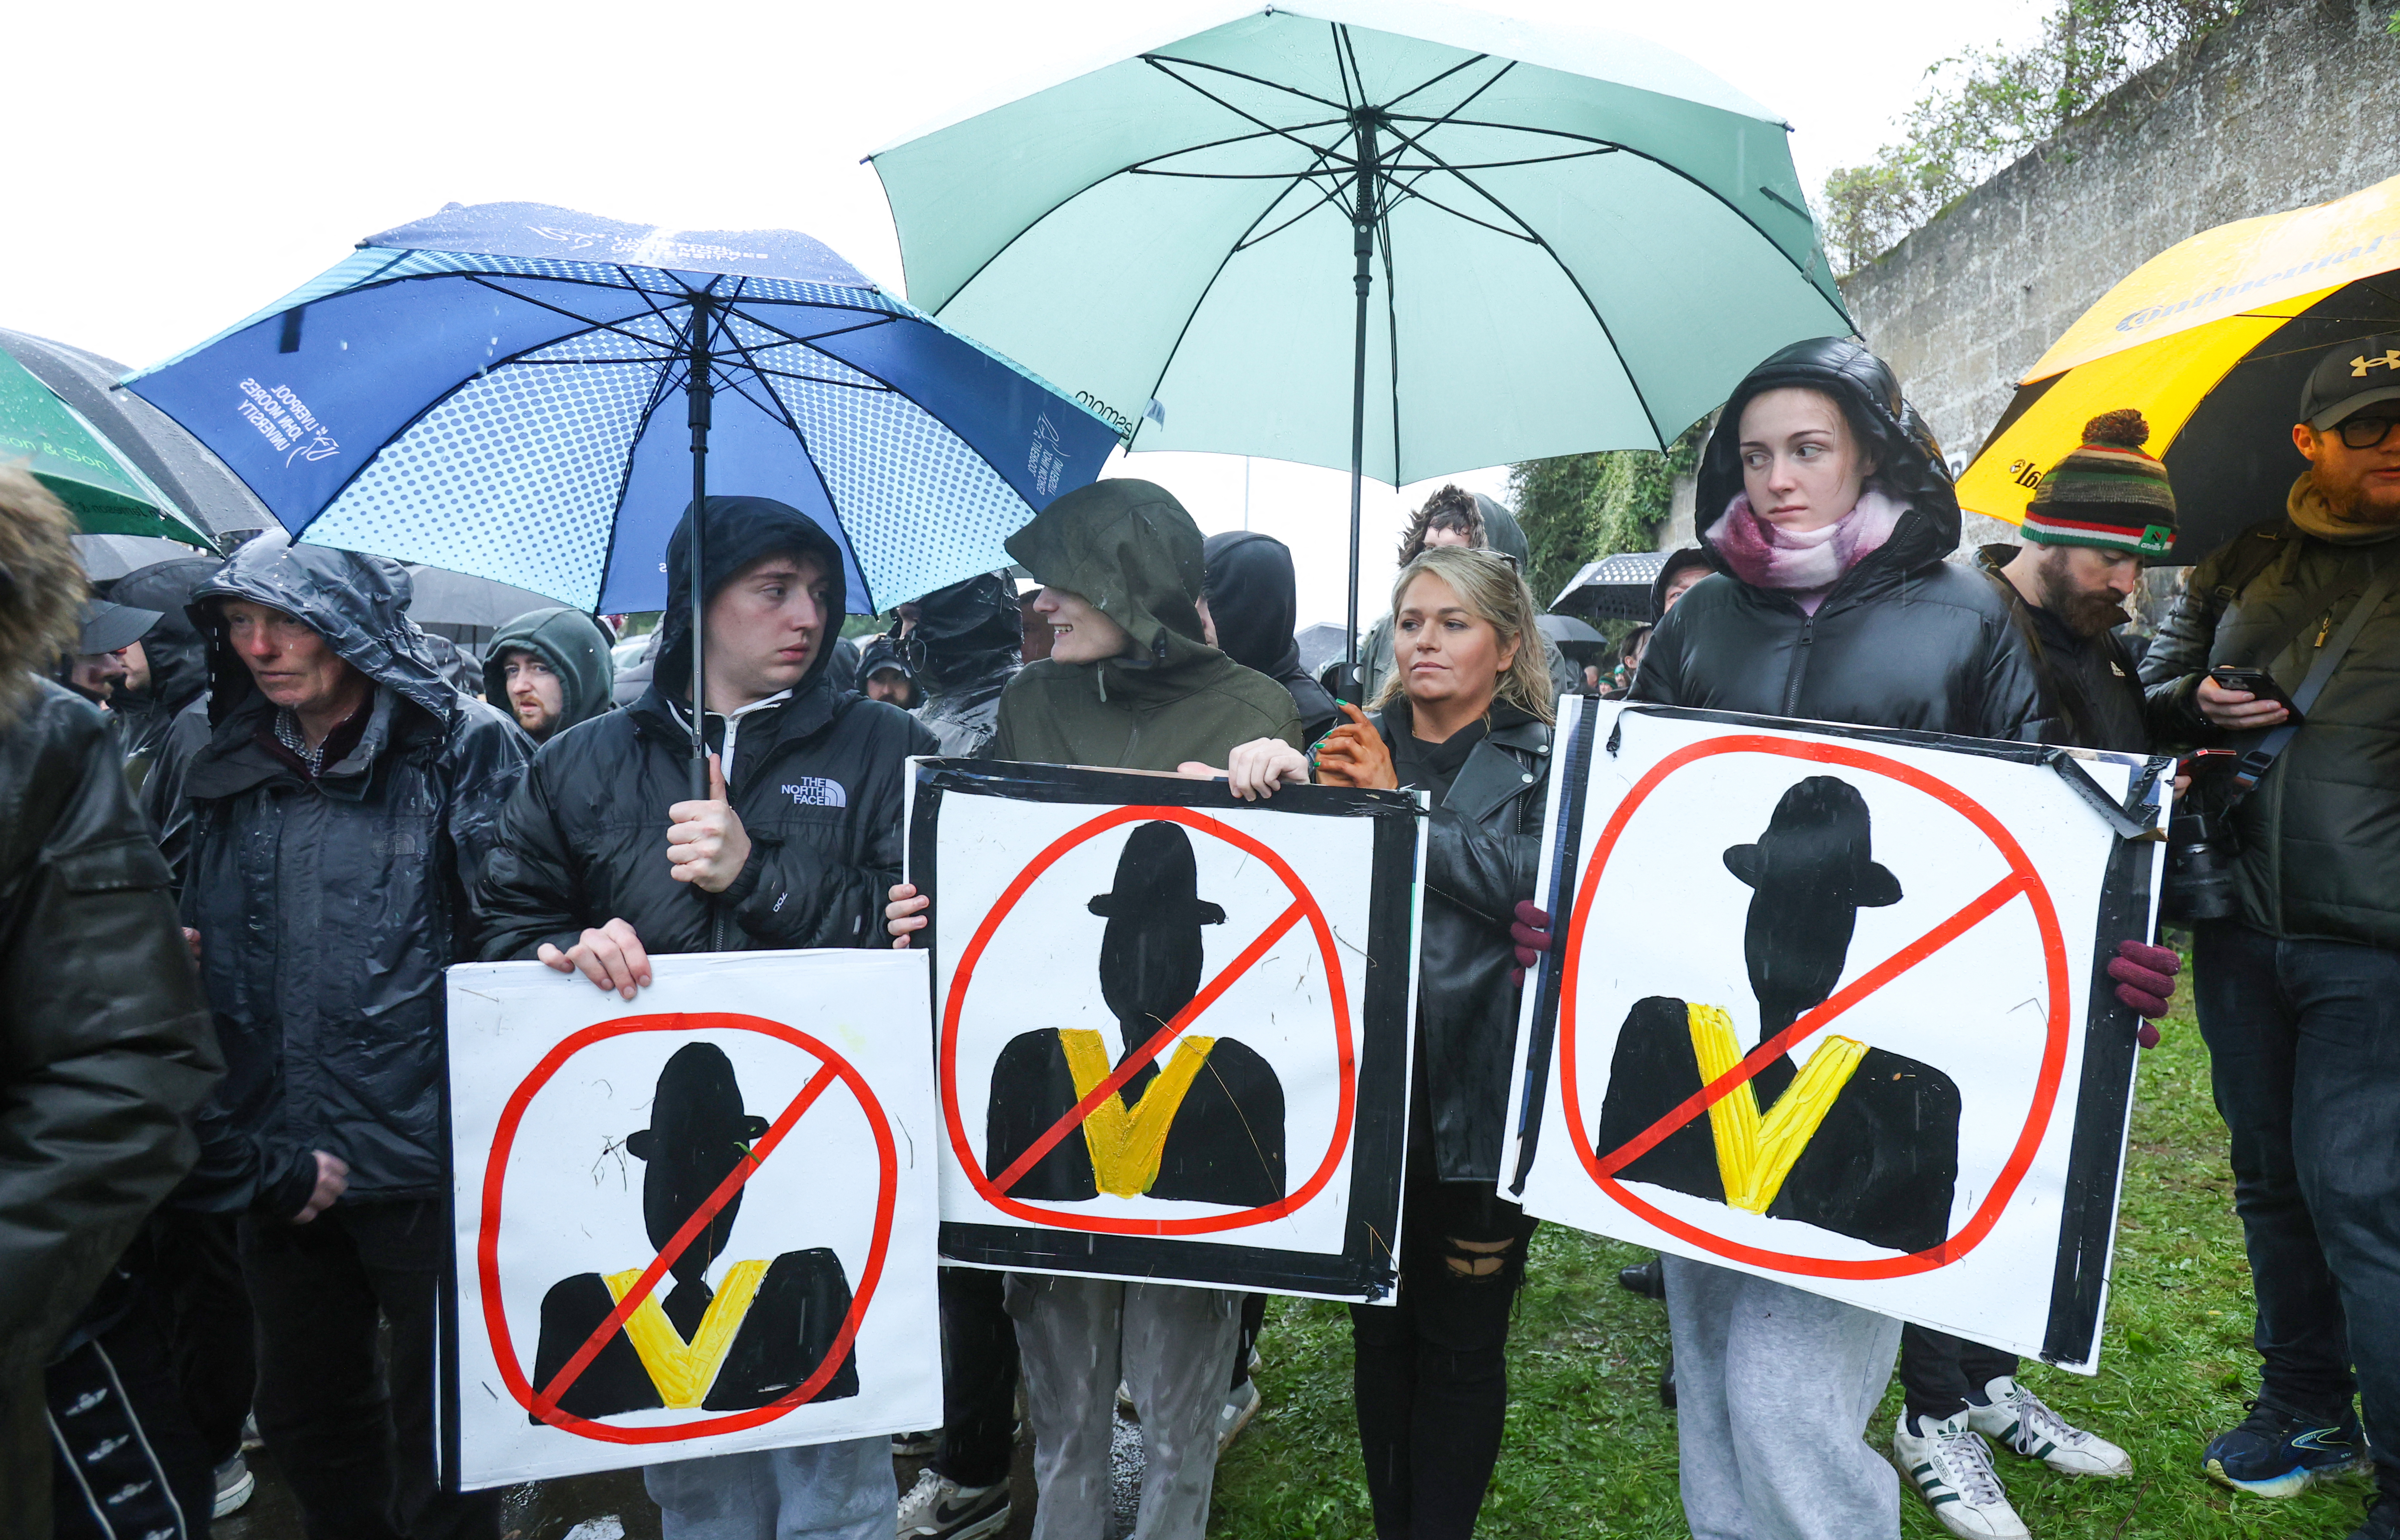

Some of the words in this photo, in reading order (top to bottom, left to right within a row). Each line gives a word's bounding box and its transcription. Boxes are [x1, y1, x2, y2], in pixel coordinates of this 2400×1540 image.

[679, 247, 768, 259] MOORES
[43, 442, 60, 457] &
[63, 447, 109, 470] Son
[801, 776, 825, 787] THE
[781, 784, 825, 796] NORTH
[793, 794, 825, 806] FACE
[2299, 1433, 2317, 1445] BROOKS
